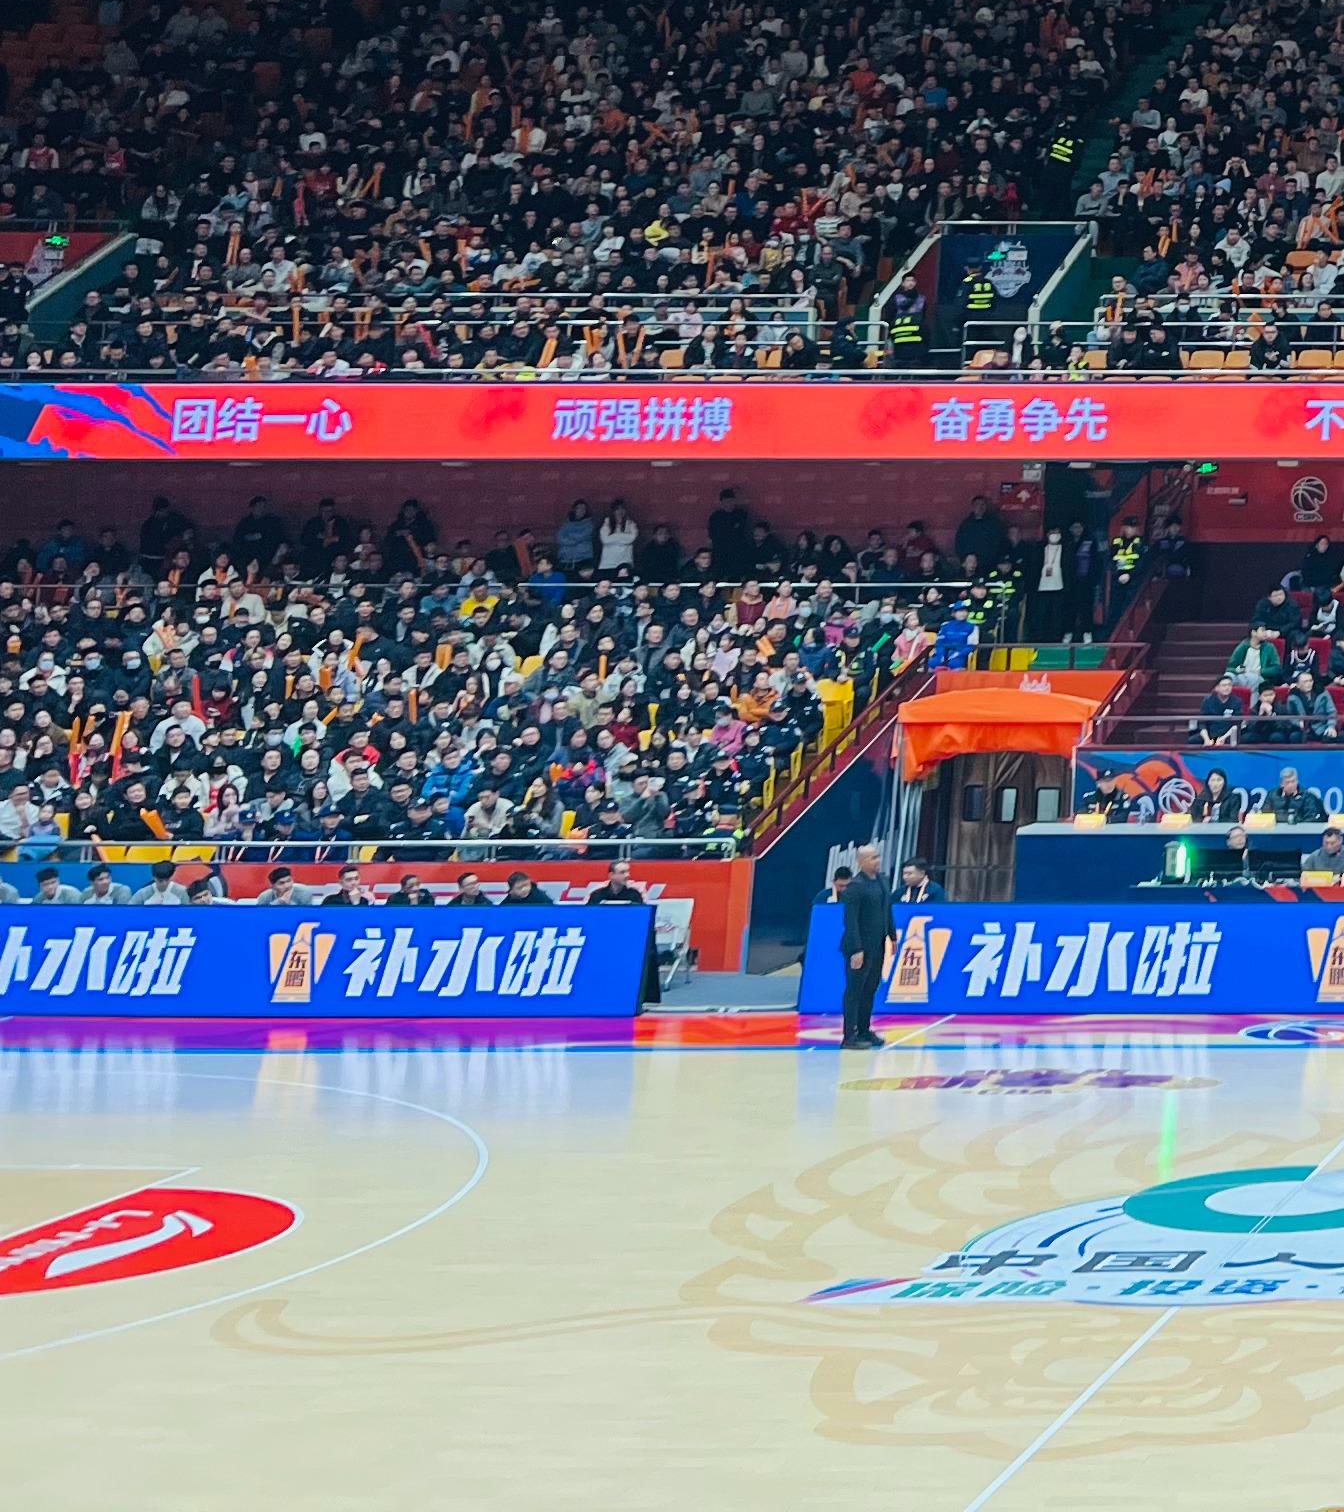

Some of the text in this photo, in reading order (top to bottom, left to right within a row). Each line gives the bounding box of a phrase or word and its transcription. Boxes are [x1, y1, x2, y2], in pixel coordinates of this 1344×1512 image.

[171, 397, 352, 442] 团结一心
[552, 397, 732, 441] 顽强拼搏
[930, 398, 1109, 442] 奋勇争先
[284, 949, 308, 989] 东鹏
[343, 926, 586, 998] 补水啦
[899, 944, 925, 987] 东鹏
[962, 920, 1222, 998] 补水啦
